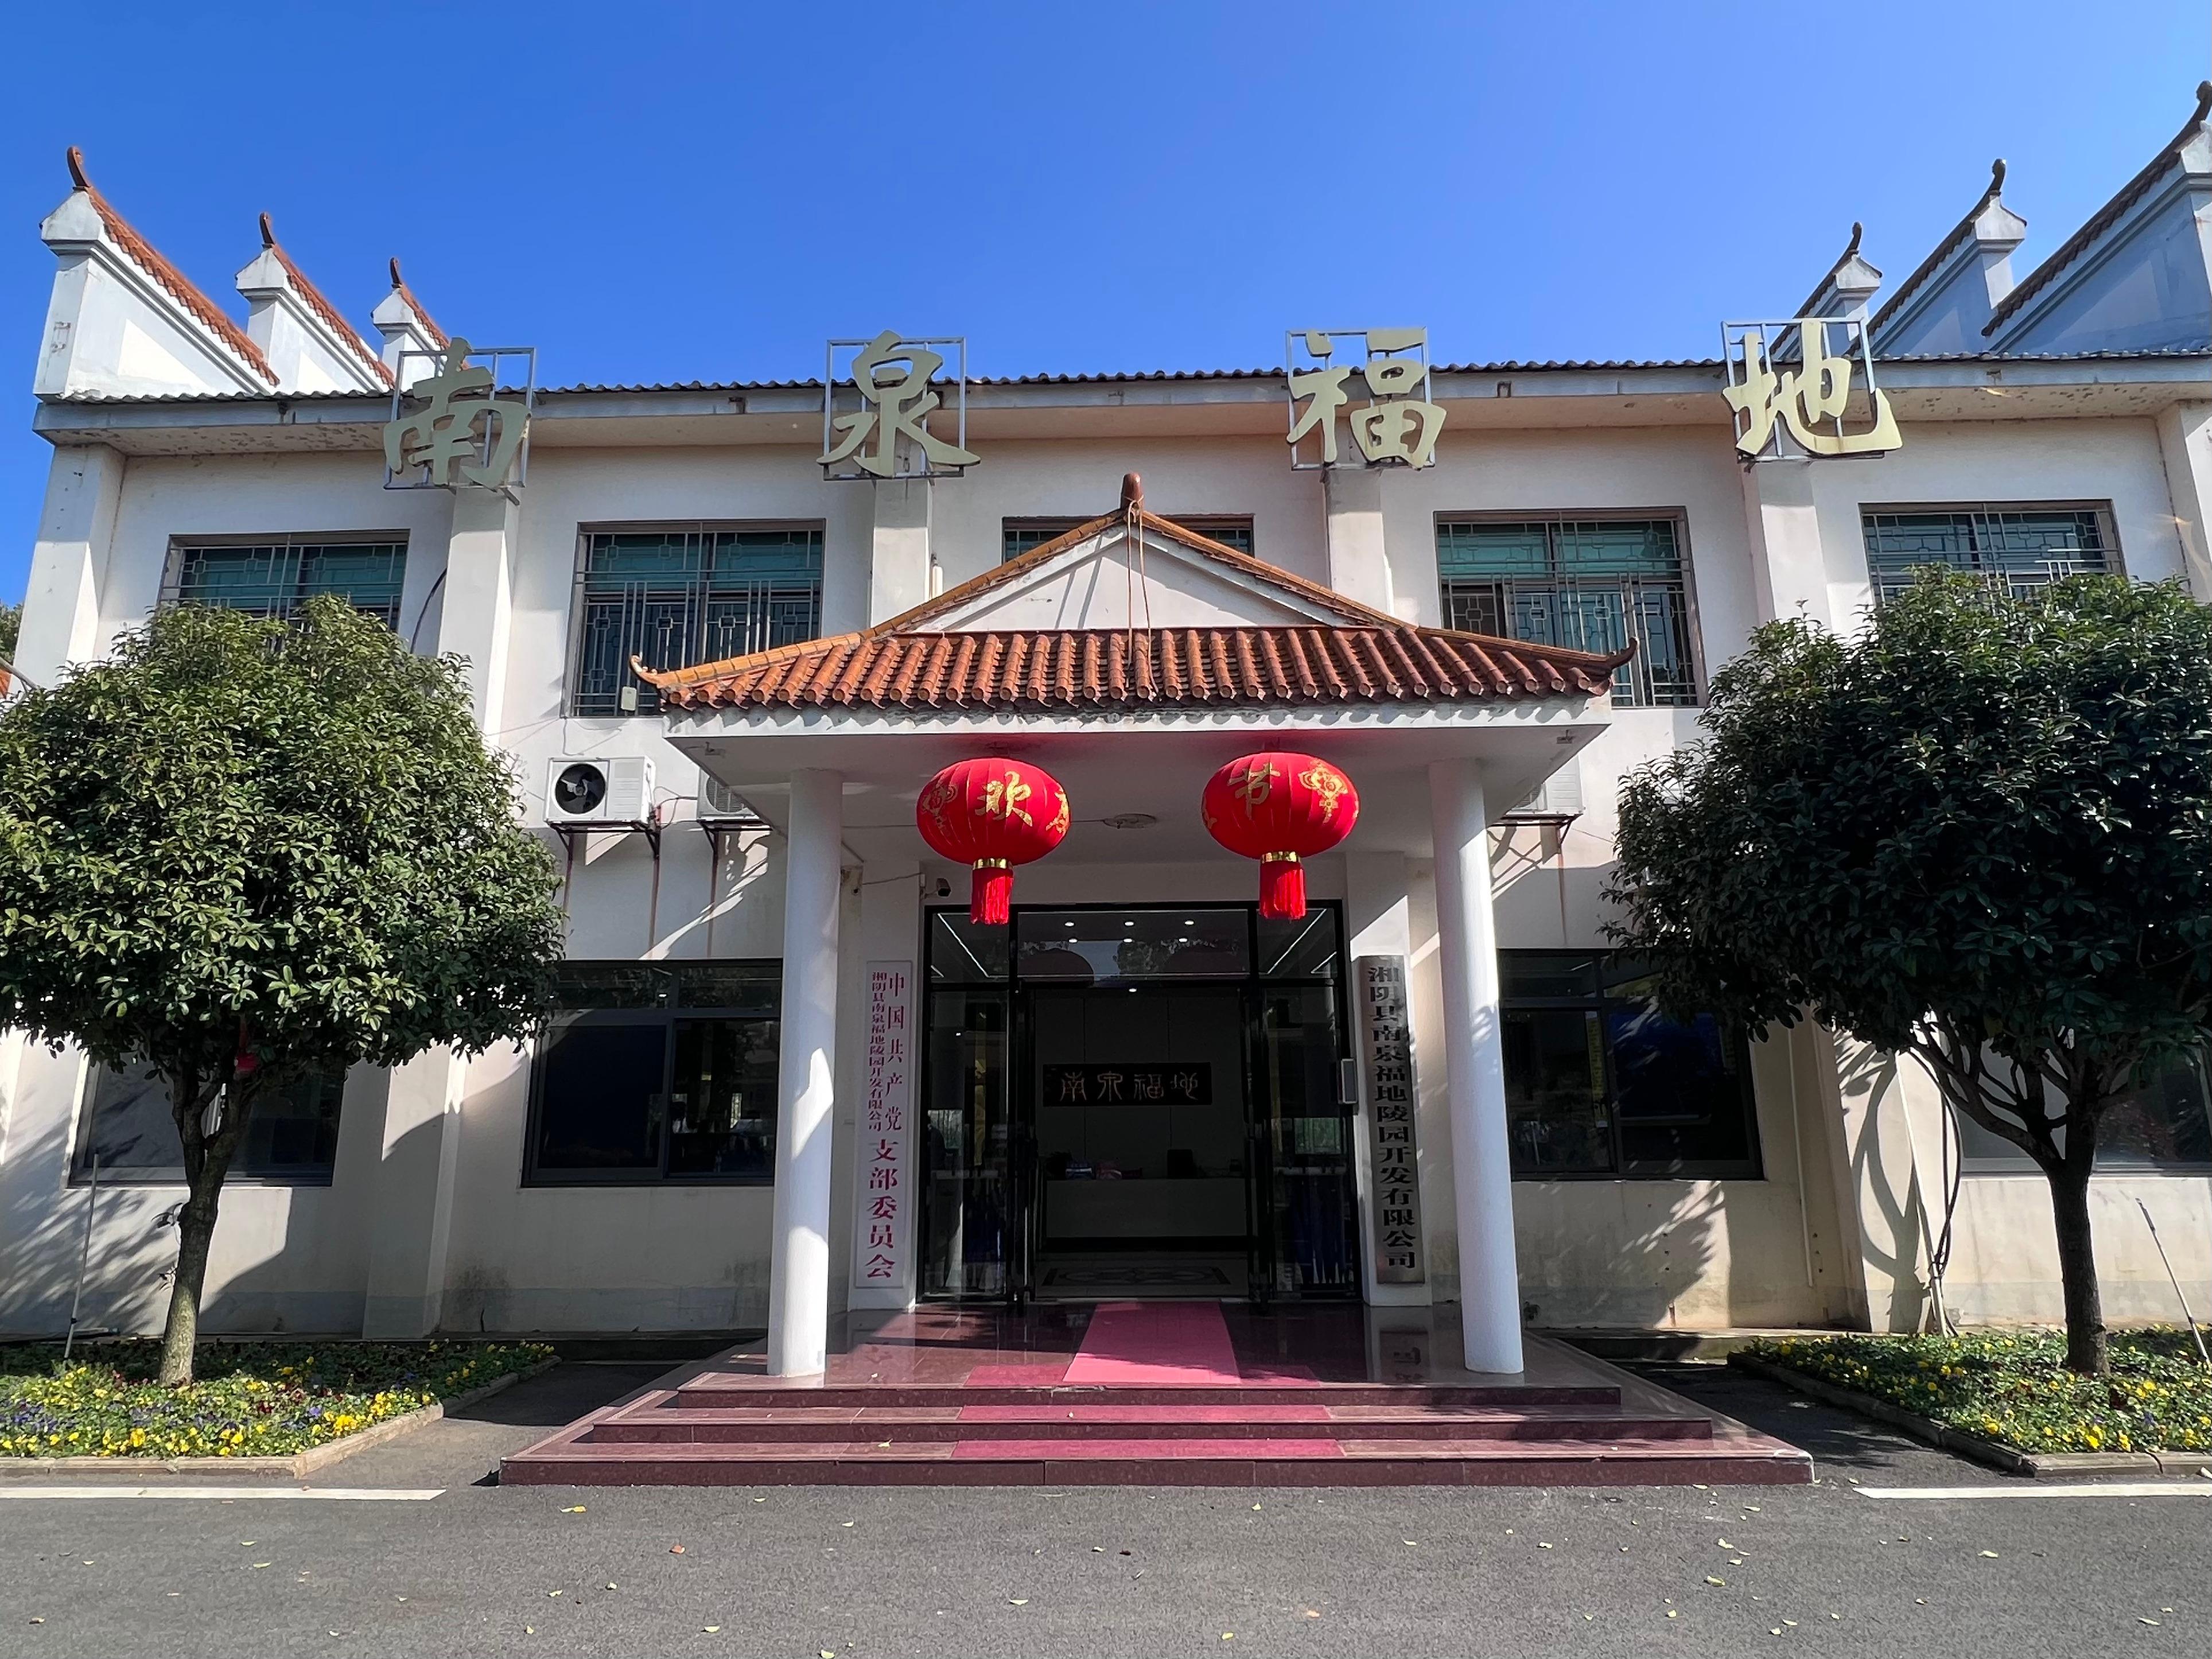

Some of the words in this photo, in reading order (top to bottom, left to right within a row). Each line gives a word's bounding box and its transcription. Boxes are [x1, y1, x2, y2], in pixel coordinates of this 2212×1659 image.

[384, 317, 1903, 488] 南泉福地
[1060, 1070, 1199, 1102] 南泉福地
